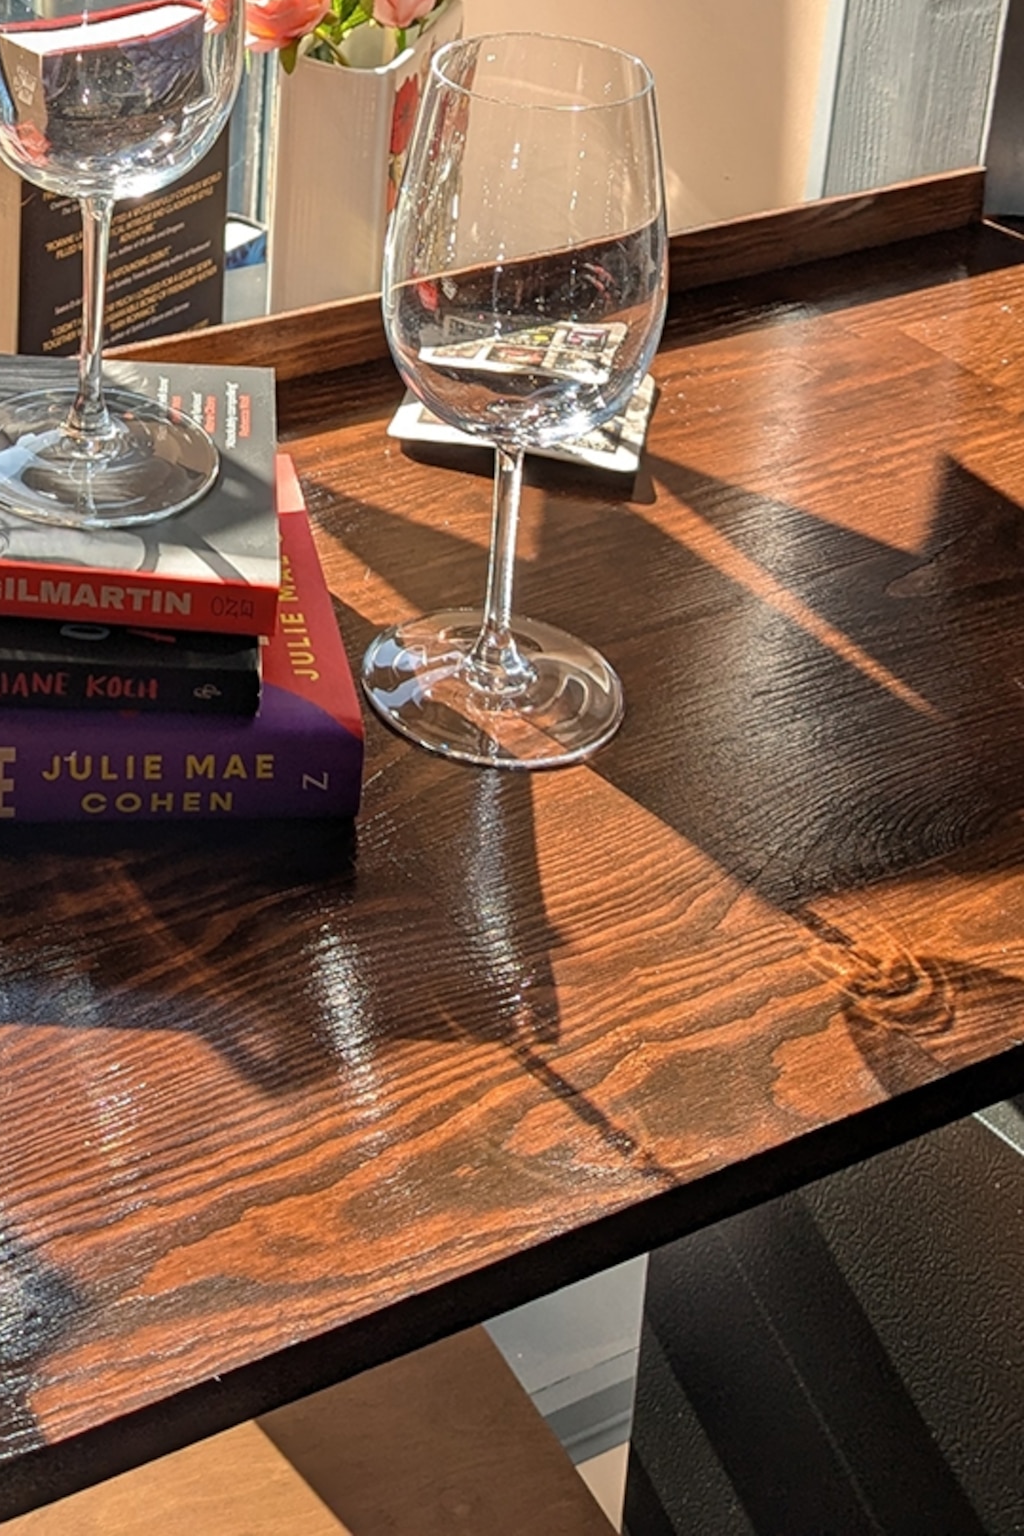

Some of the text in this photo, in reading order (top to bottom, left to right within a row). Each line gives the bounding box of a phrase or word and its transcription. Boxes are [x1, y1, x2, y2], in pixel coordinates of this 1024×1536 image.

[279, 613, 320, 681] JULIE
[86, 674, 159, 700] KOCH
[41, 753, 275, 782] JULIE MAE
[80, 791, 234, 814] COHEN
